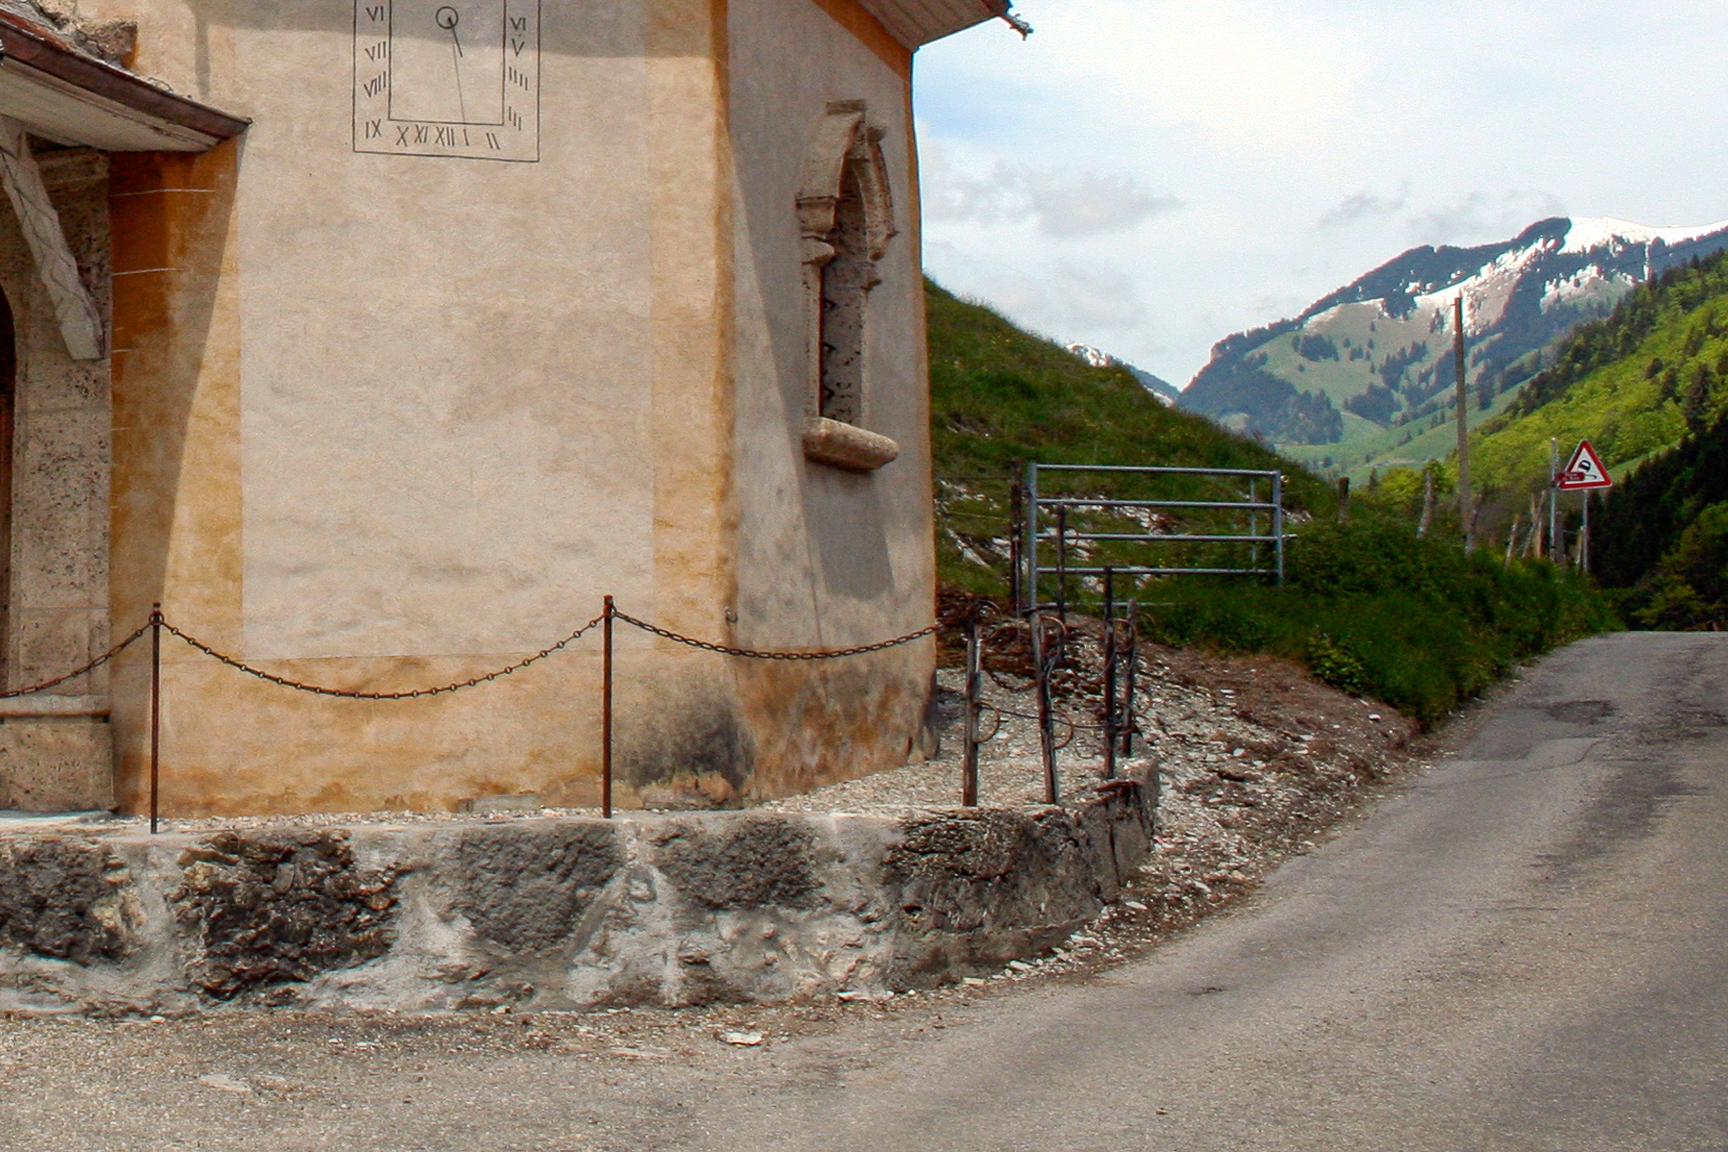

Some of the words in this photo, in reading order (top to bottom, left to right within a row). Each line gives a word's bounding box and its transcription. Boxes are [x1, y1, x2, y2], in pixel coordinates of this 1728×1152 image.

[365, 5, 384, 22] VI
[510, 17, 526, 31] VI
[365, 41, 386, 62] VII
[511, 38, 525, 57] V
[363, 71, 386, 98] VIII
[508, 66, 528, 91] IIII
[365, 119, 382, 139] IX
[508, 106, 521, 131] III
[396, 125, 409, 147] X
[414, 124, 429, 143] XI
[435, 126, 455, 147] XII
[485, 132, 501, 150] II
